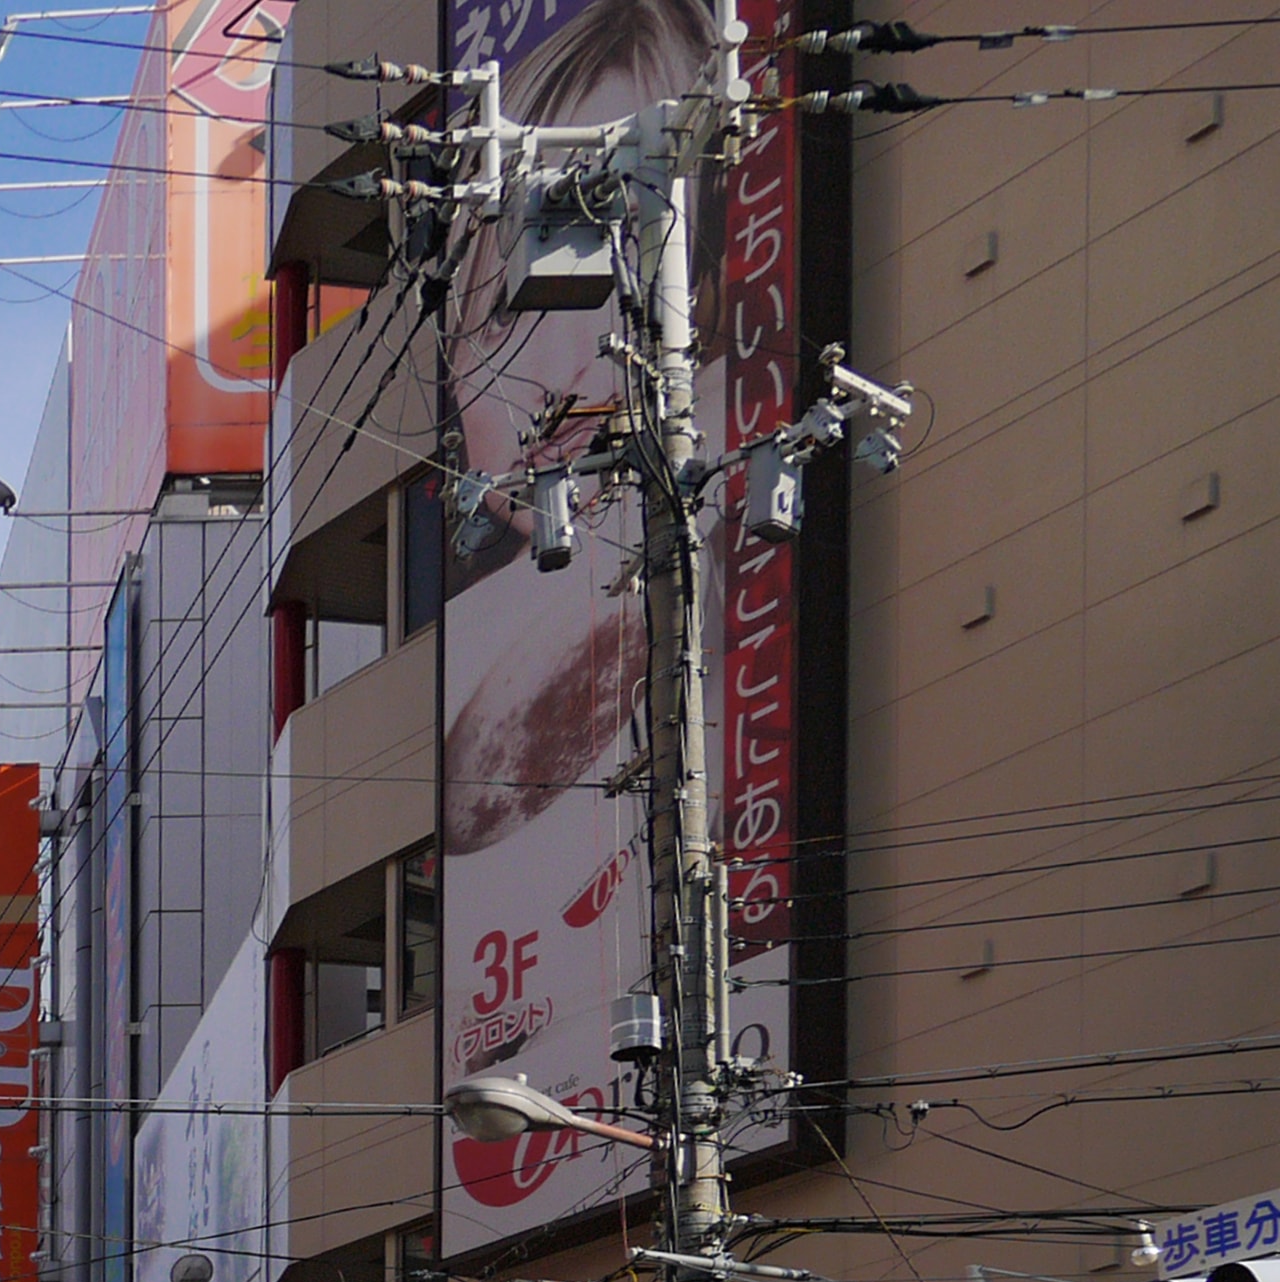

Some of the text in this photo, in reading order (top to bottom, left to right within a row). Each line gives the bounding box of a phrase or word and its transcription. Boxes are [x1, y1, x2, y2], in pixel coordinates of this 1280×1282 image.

[472, 930, 539, 1018] 3F
[454, 997, 553, 1063] (フロント)
